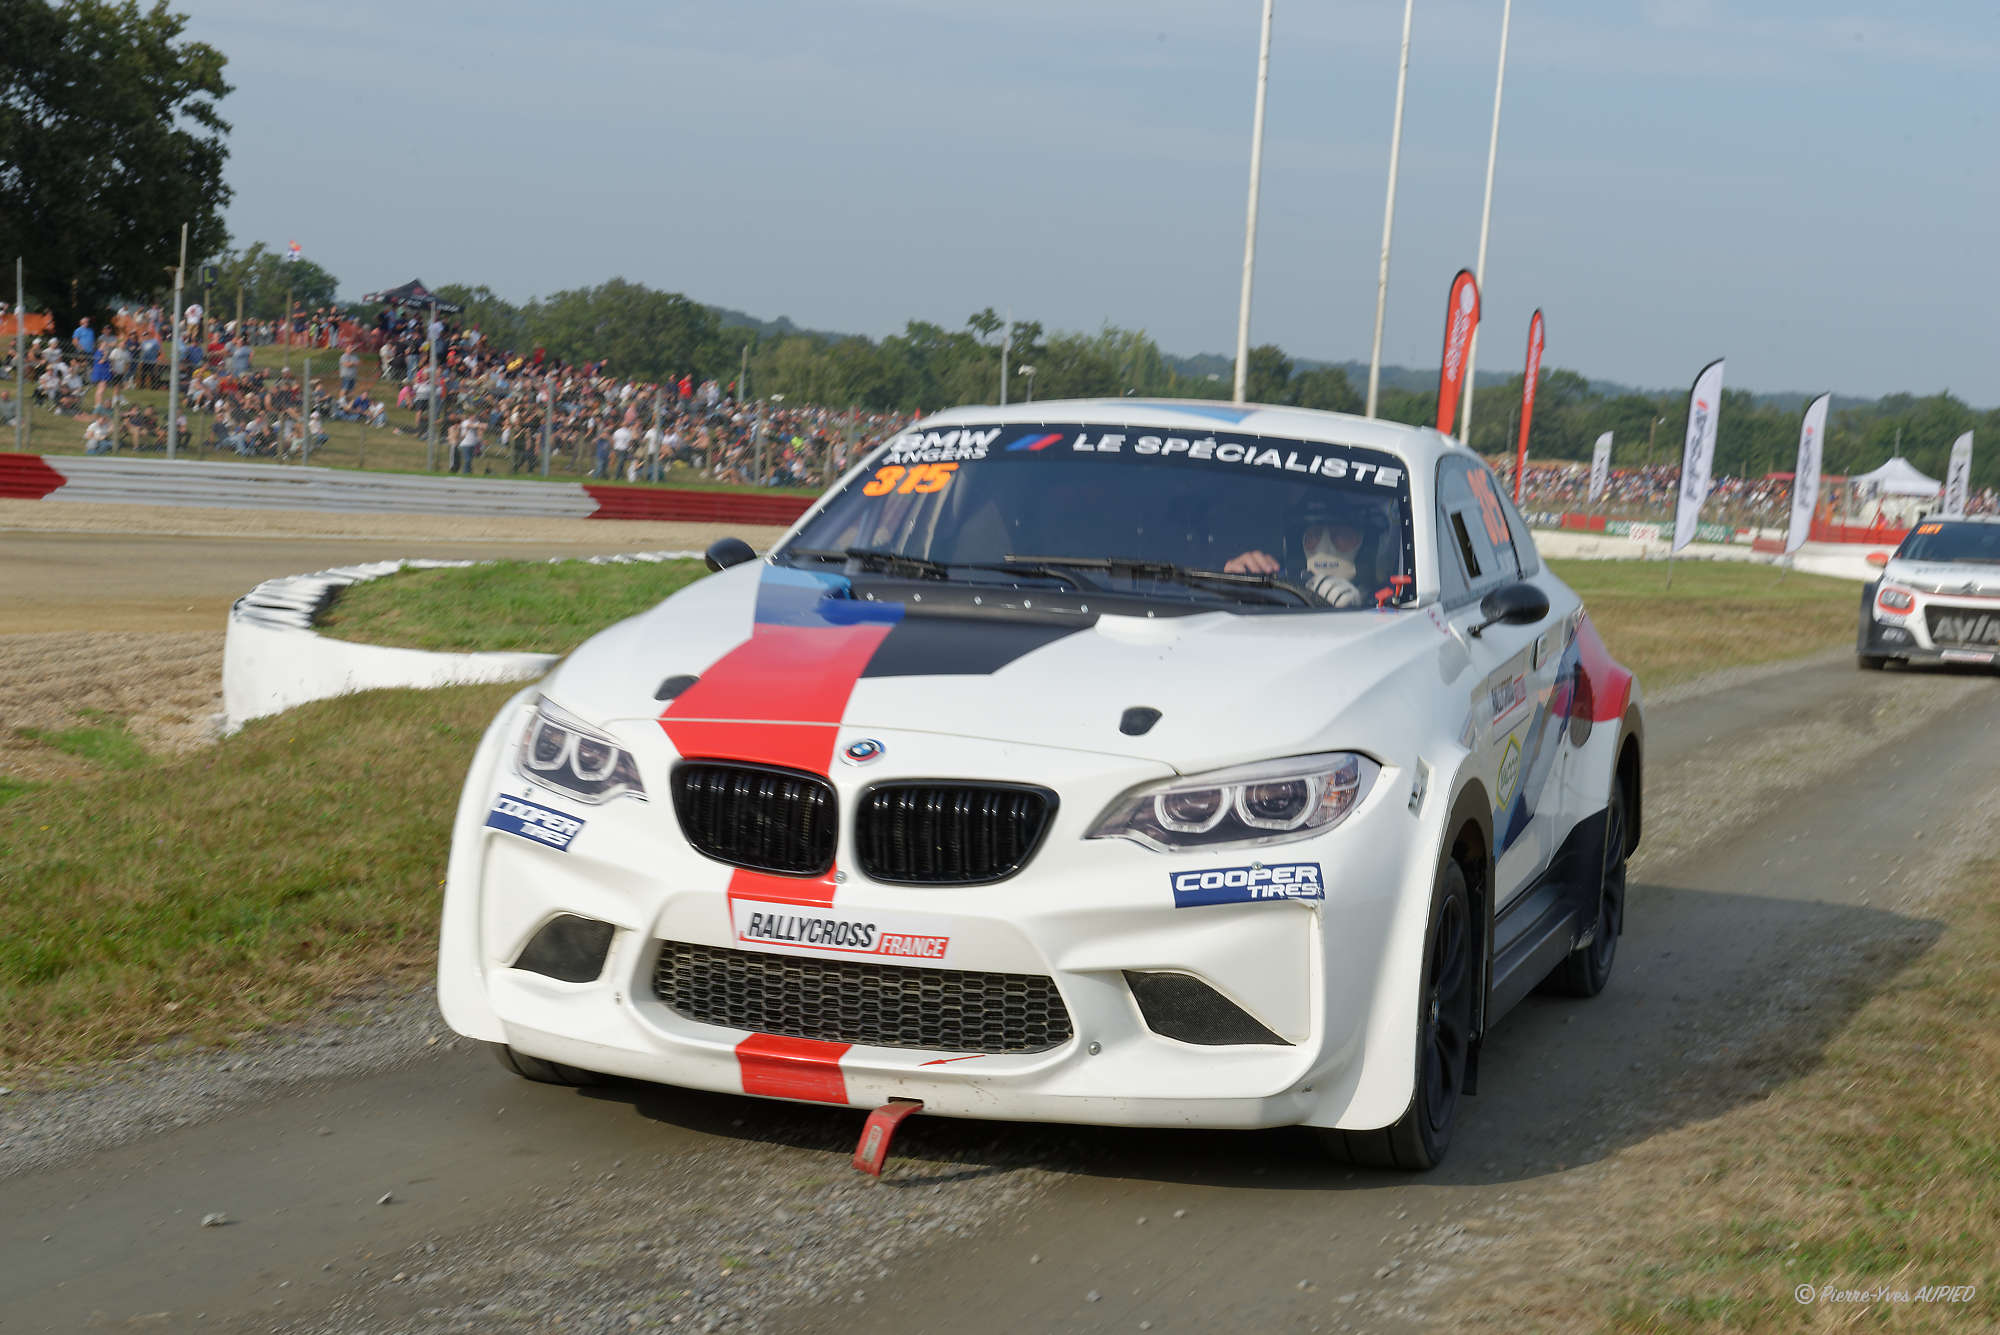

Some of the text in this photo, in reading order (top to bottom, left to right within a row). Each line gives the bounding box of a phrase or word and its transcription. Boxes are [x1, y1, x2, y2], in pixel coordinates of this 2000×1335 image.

[882, 446, 989, 465] ANGERS
[1072, 433, 1403, 488] LE SPÉCIALISTE
[862, 462, 960, 496] 315
[1175, 865, 1318, 892] COOPER
[1247, 883, 1320, 898] TIRES
[747, 912, 947, 958] RALLYCROSS FRANCE
